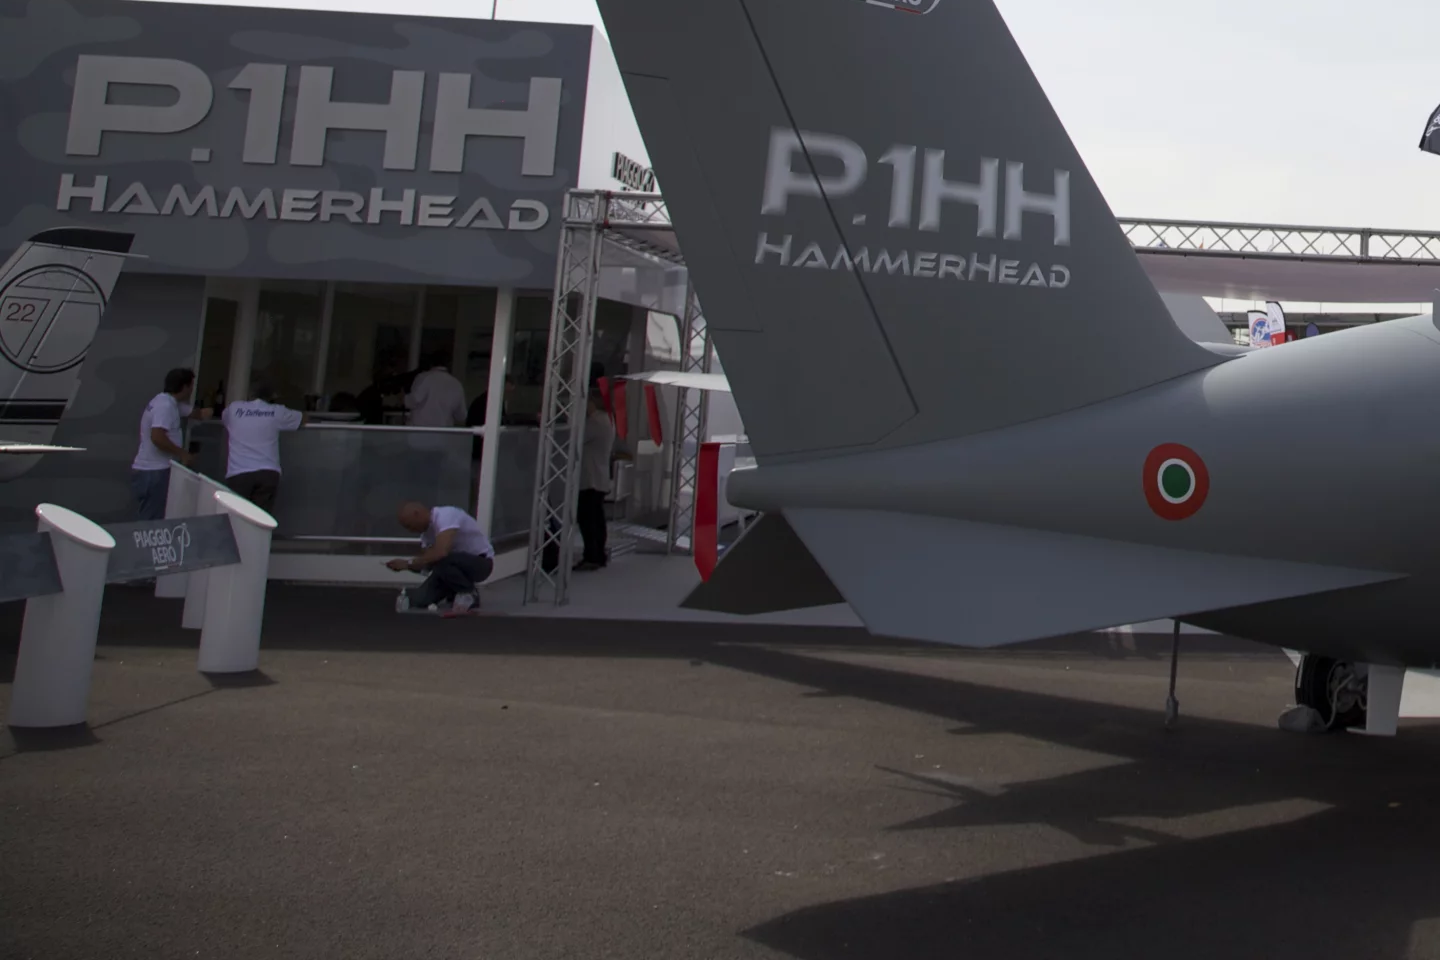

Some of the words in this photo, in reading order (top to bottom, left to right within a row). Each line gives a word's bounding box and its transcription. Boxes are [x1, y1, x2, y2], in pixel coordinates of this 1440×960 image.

[66, 55, 562, 176] P.1HH
[56, 174, 549, 230] HAMMERHEAD
[761, 126, 1071, 246] P.1HH
[754, 231, 1071, 288] HAMMERHEAD
[6, 302, 36, 322] 22
[133, 528, 171, 547] PIAGGIO
[152, 546, 176, 564] AERO
